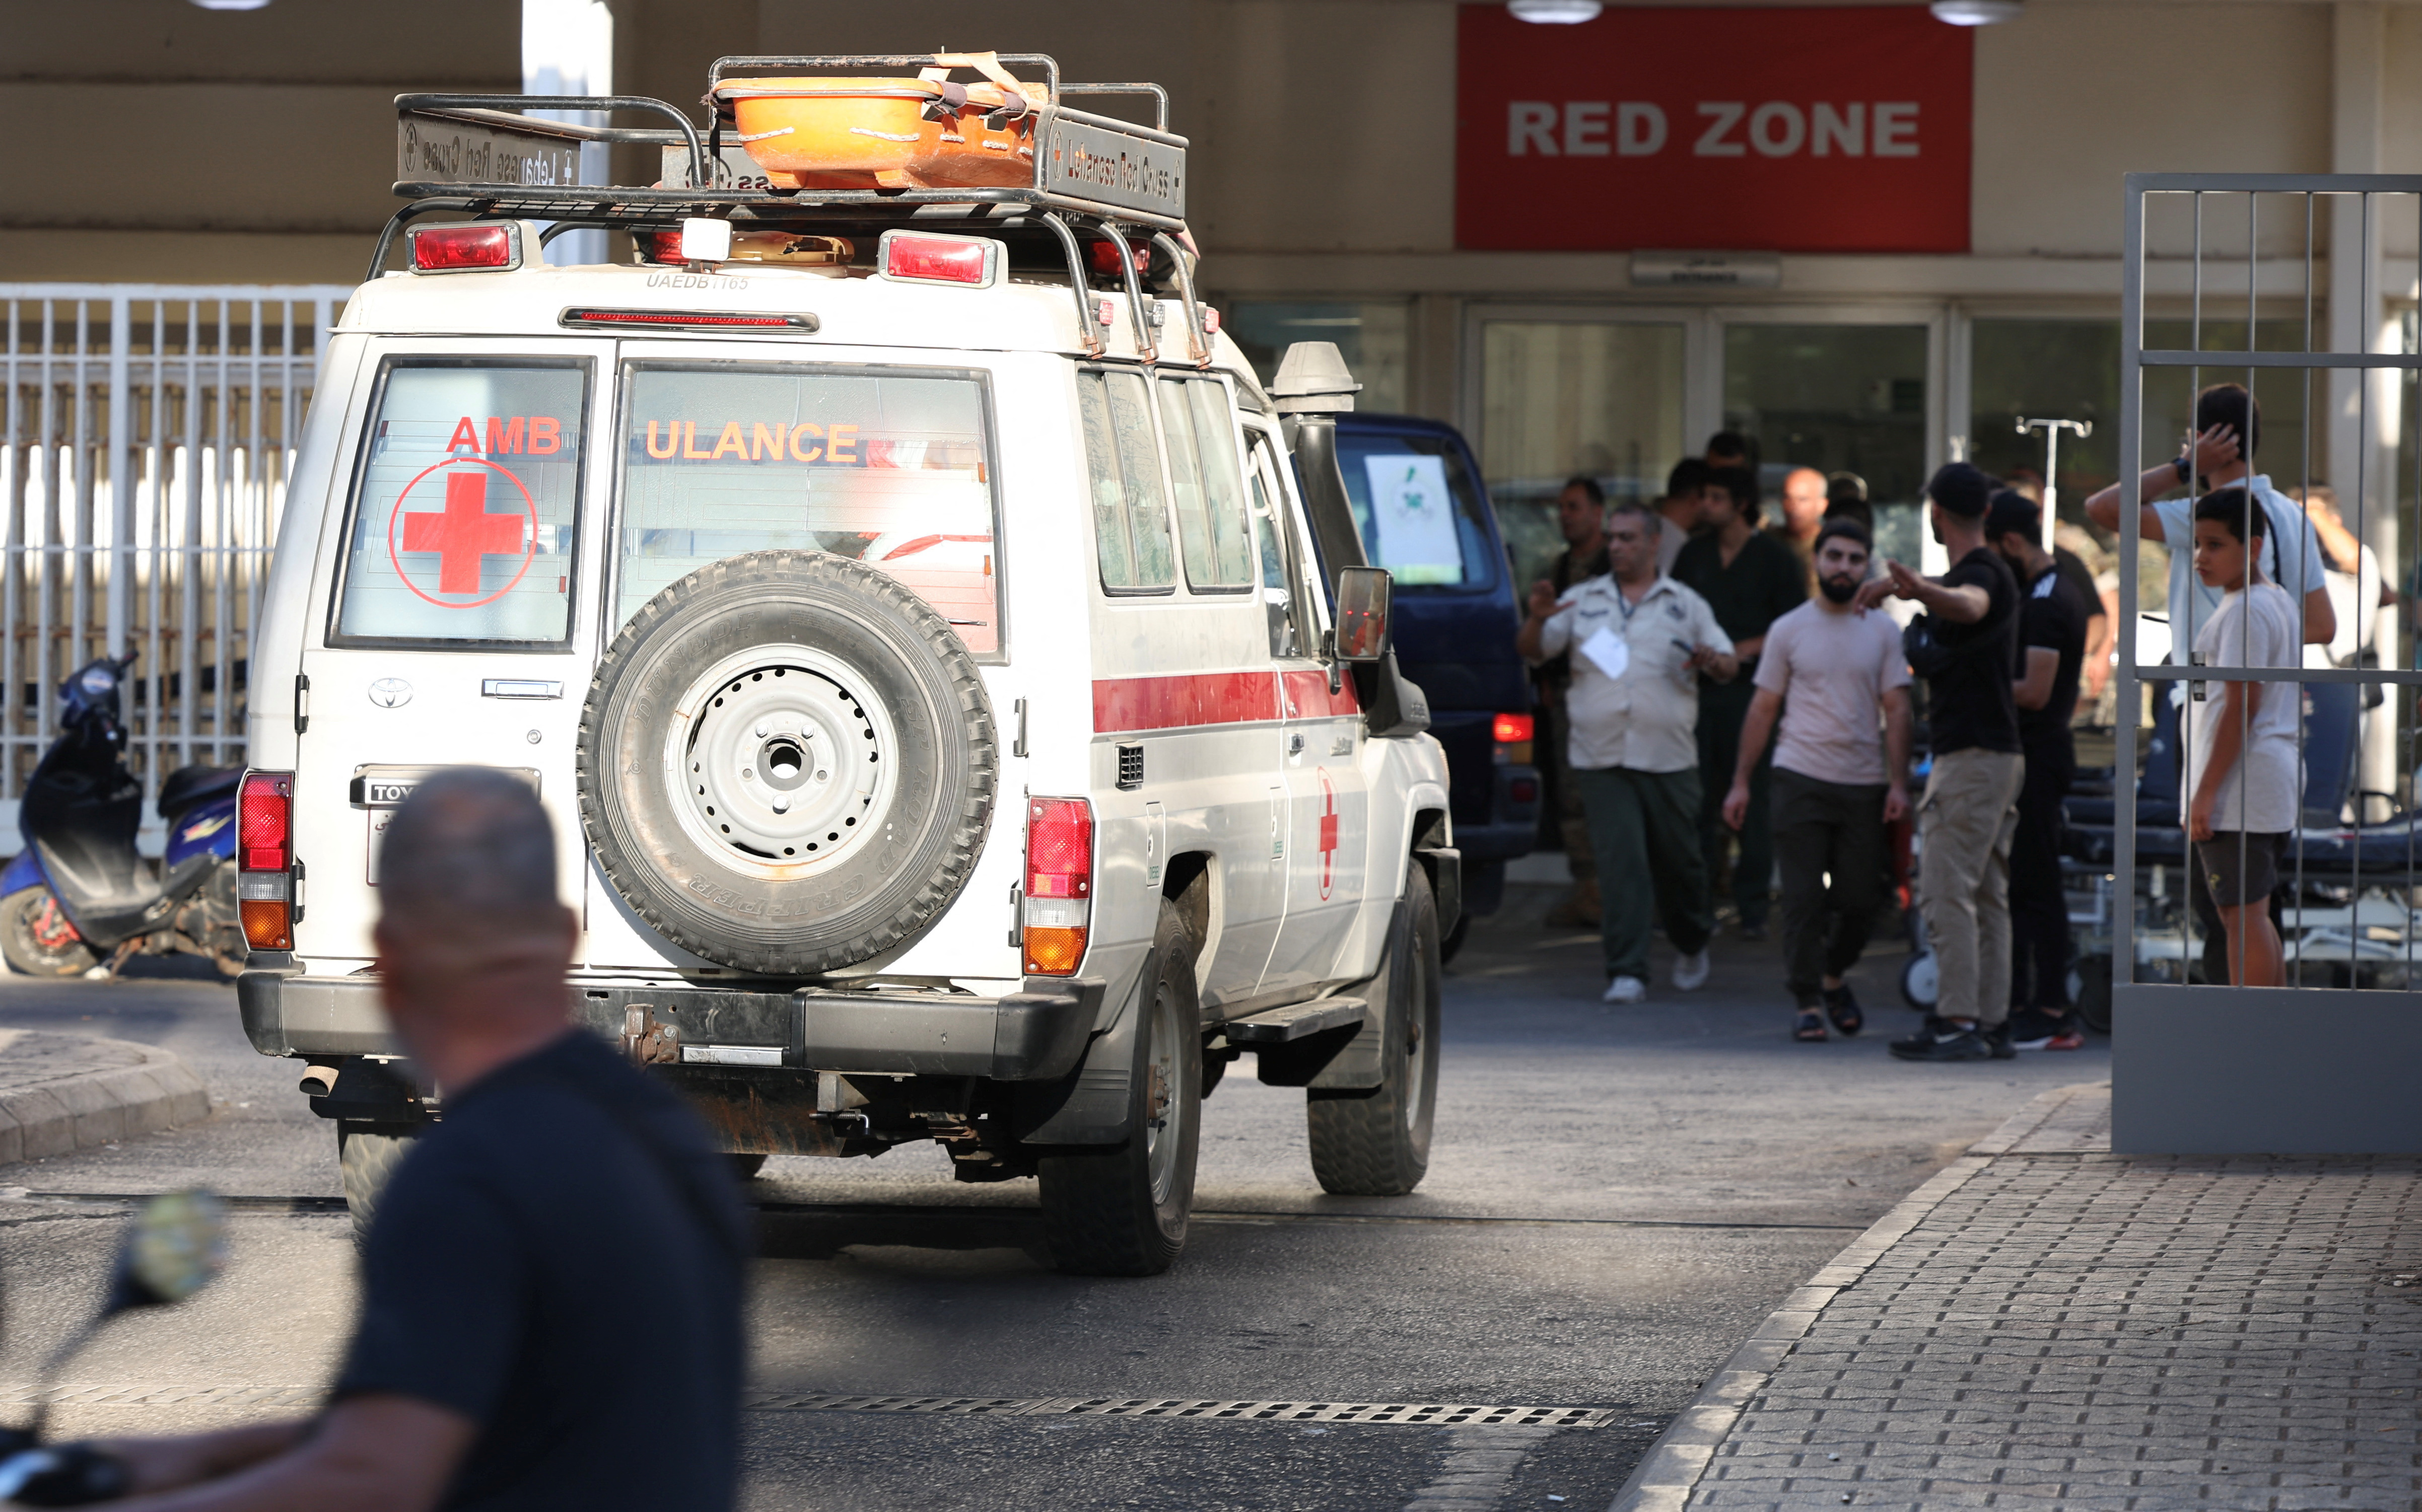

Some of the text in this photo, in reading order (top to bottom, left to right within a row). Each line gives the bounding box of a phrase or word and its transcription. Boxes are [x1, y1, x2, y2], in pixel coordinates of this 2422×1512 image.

[1507, 101, 1920, 157] RED ZONE
[1068, 139, 1168, 199] Lebanese Red Cross
[647, 274, 749, 290] UAEDB1165
[445, 416, 859, 463] AMB ULANCE
[634, 609, 762, 729] DUNLOP
[374, 786, 414, 801] TOY
